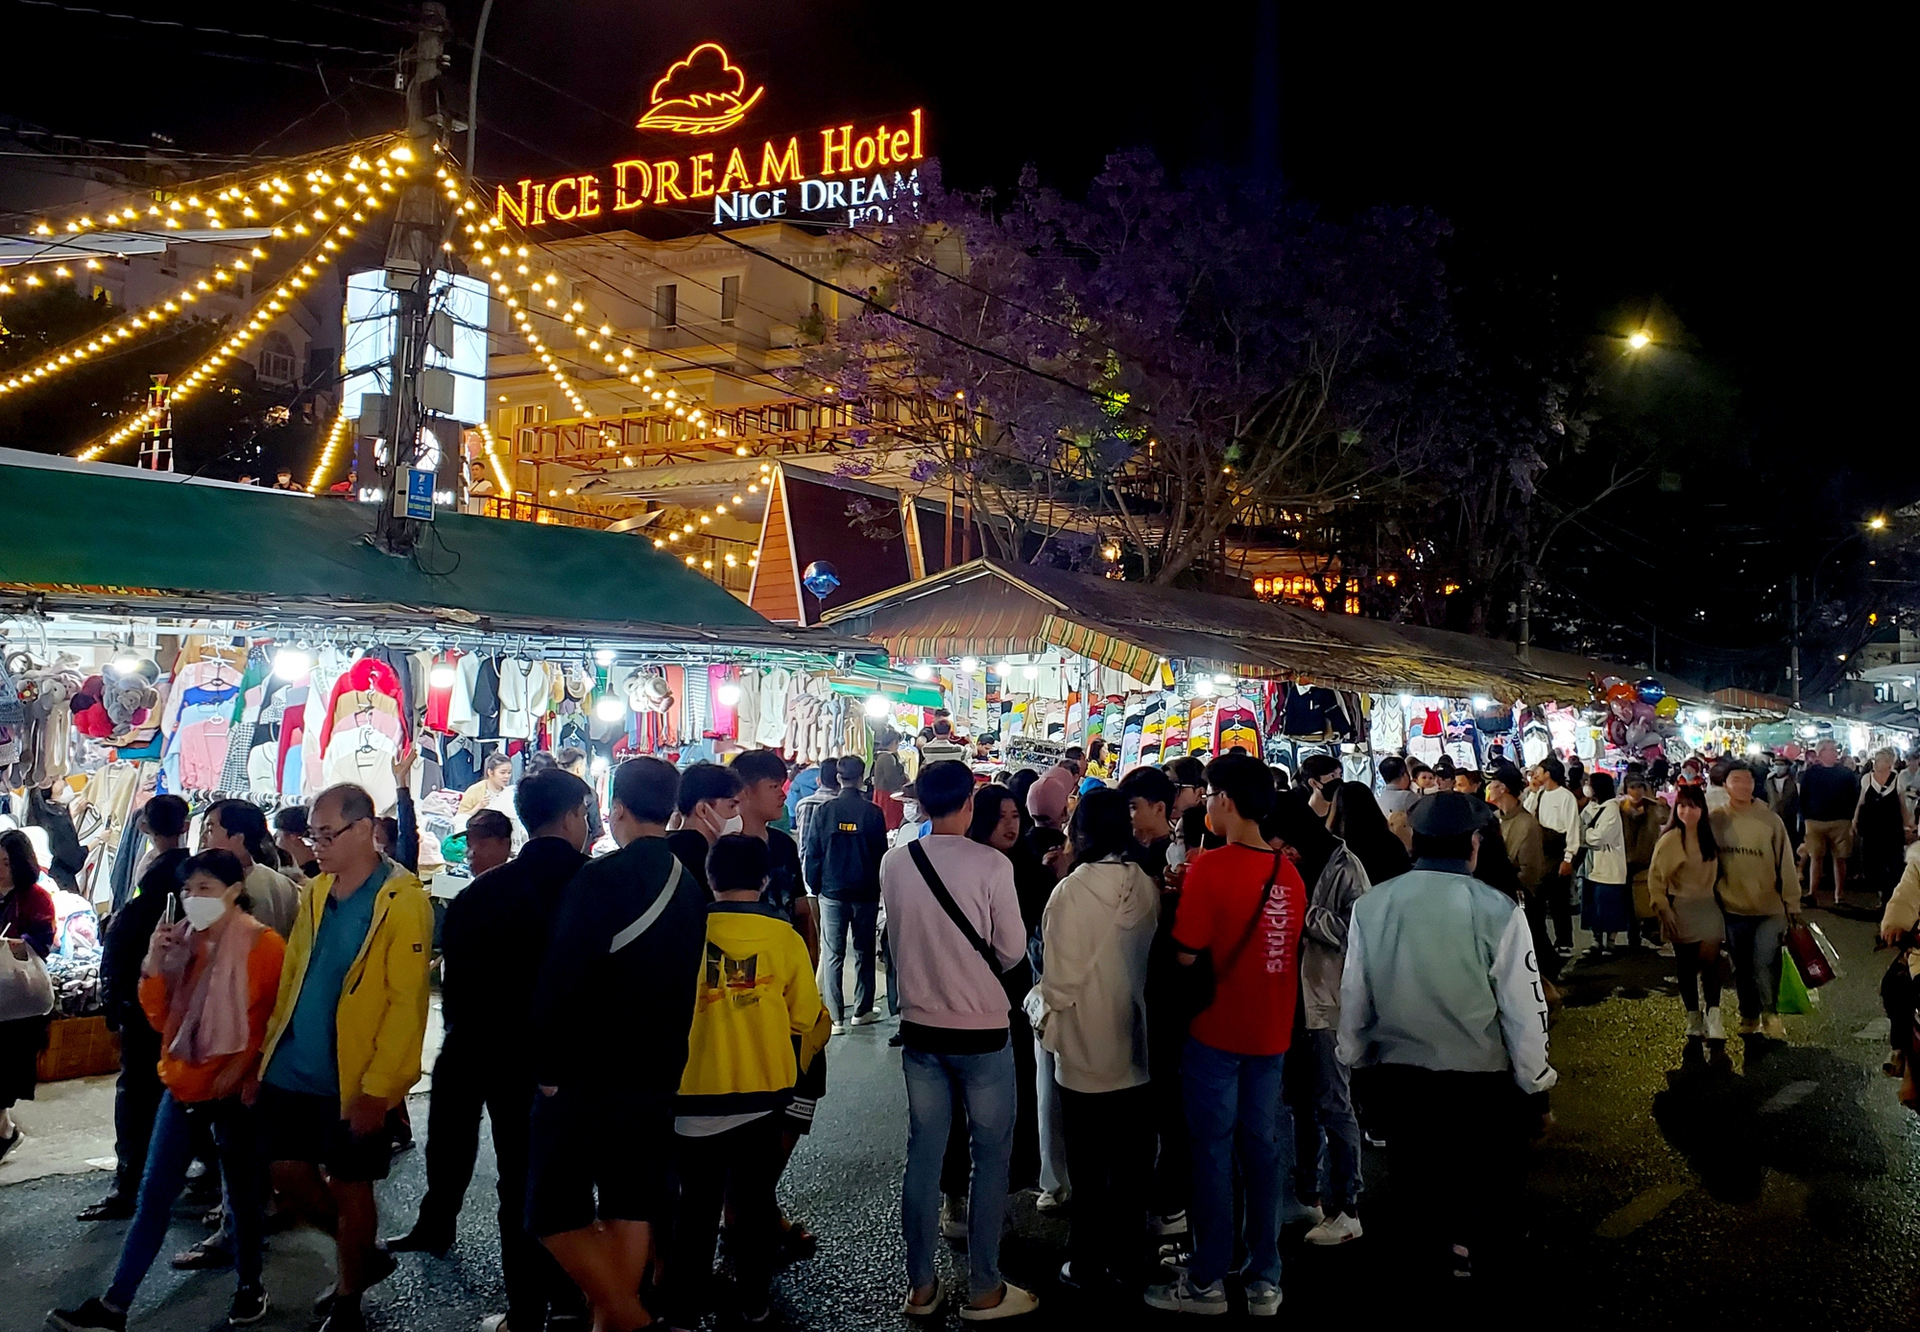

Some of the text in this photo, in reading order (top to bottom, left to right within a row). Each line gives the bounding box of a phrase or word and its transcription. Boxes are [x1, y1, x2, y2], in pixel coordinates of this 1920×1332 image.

[494, 108, 923, 231] NICE DREAM Hotel
[712, 188, 788, 226] NICE
